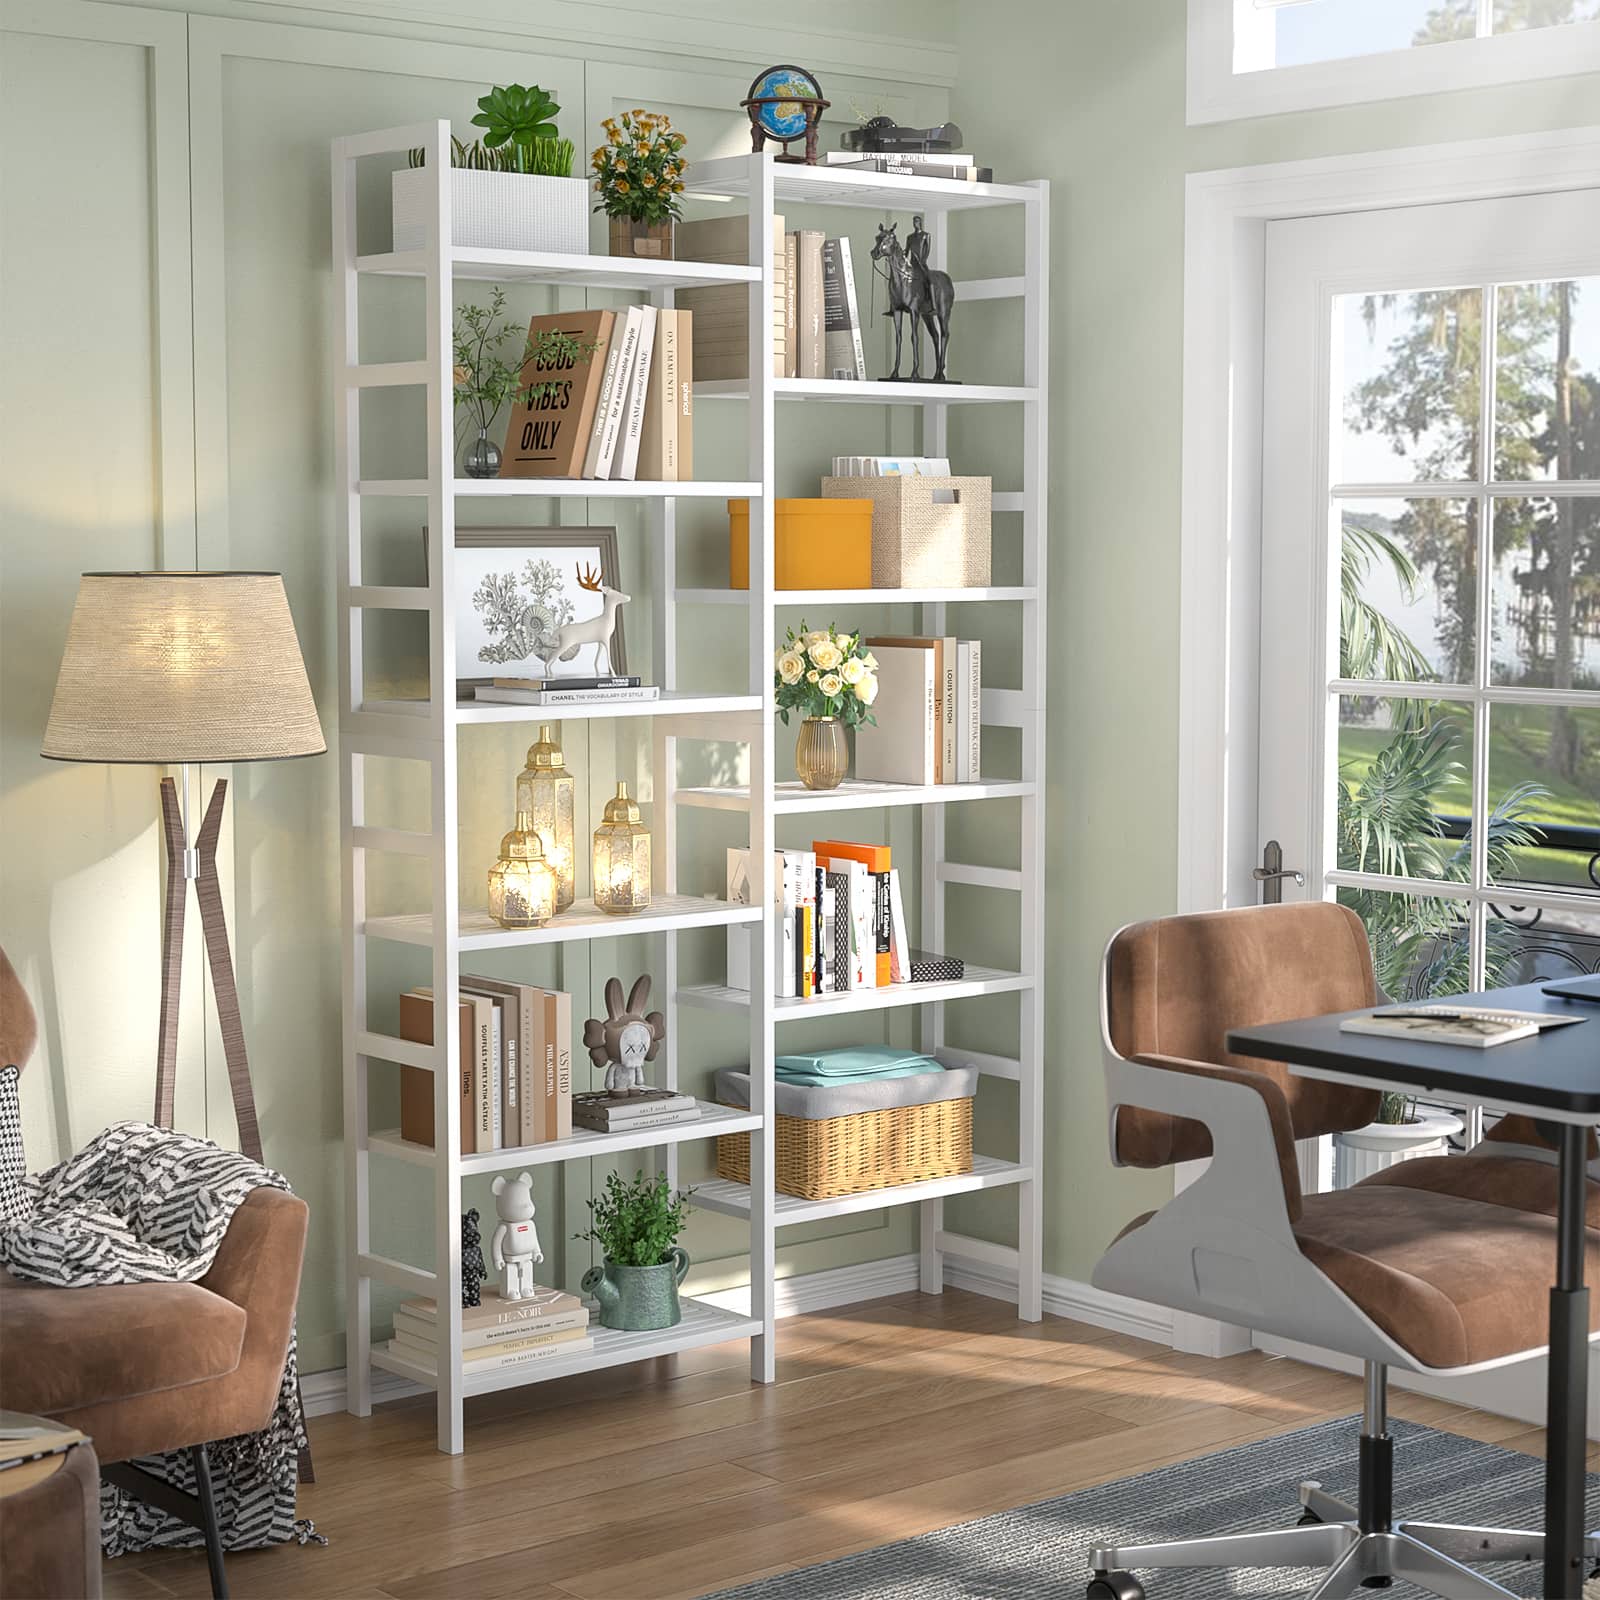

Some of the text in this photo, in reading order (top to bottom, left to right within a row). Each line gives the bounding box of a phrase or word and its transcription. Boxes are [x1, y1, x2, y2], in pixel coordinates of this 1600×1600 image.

[667, 331, 674, 344] ON
[604, 375, 613, 400] GOOD
[609, 349, 618, 374] GUIDE
[616, 357, 628, 399] sustainable
[625, 327, 636, 357] lifestyle
[527, 380, 573, 412] VIBES
[631, 406, 640, 436] DREAM
[638, 350, 648, 381] AWAKE
[521, 420, 562, 450] ONLY
[587, 692, 620, 700] VOCABULARY
[972, 700, 978, 709] BY
